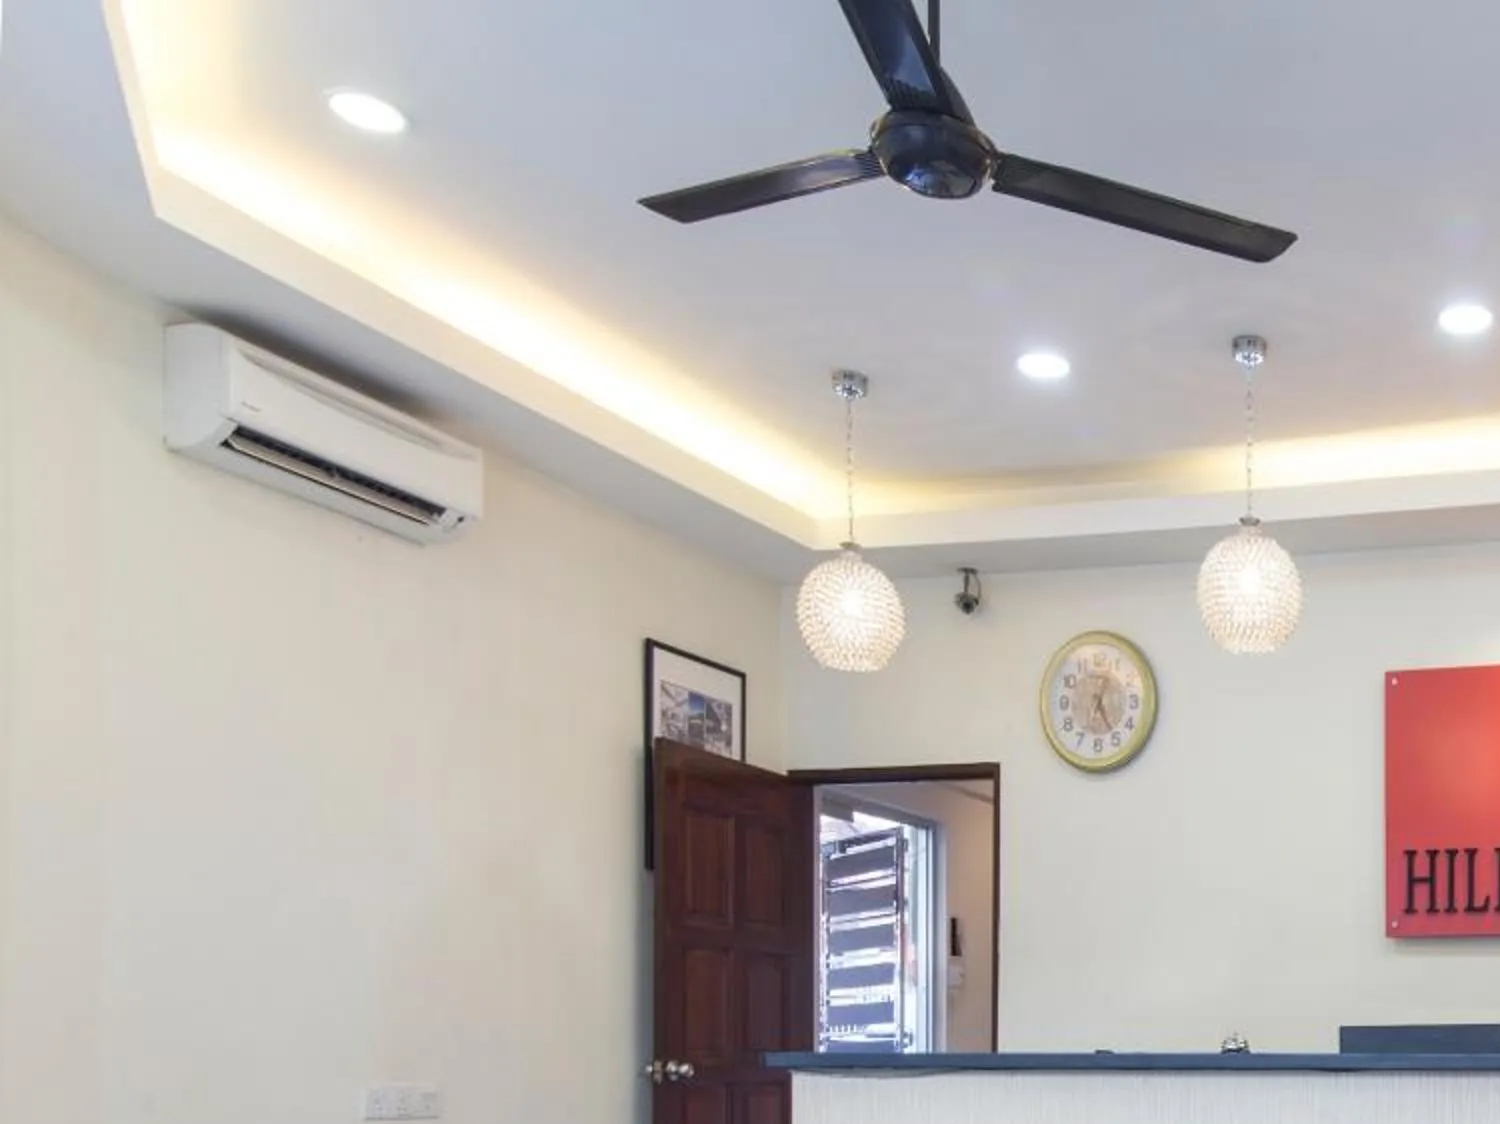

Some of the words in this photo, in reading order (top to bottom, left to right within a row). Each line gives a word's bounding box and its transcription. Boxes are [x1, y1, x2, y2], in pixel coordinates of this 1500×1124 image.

[1063, 673, 1077, 689] 10
[1059, 695, 1070, 711] 9
[1129, 694, 1139, 710] 3
[1062, 717, 1074, 732] 8
[1124, 716, 1135, 731] 4
[1075, 732, 1085, 749] 7
[1092, 738, 1103, 753] 6
[1110, 731, 1121, 747] 5
